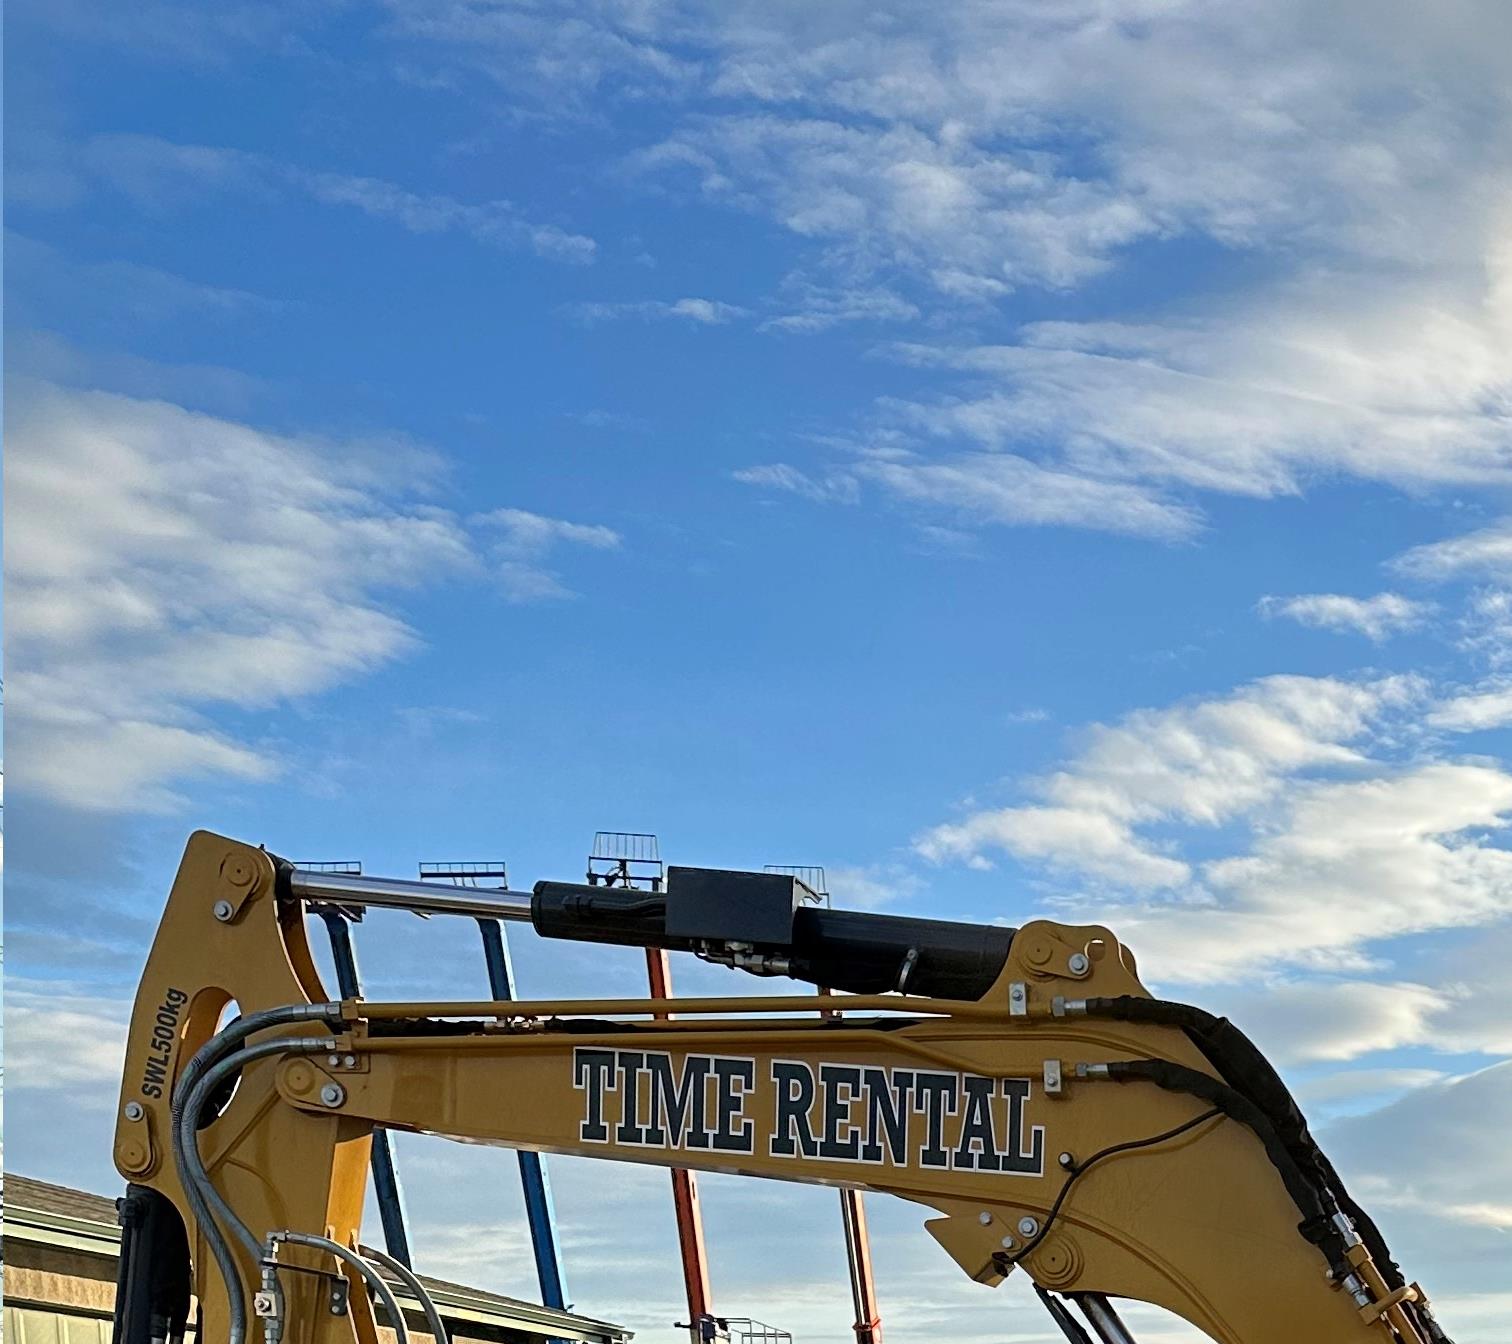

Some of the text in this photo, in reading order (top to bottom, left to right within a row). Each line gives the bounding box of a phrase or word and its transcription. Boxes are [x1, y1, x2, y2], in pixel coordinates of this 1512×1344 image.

[141, 988, 188, 1099] SWL500kg
[573, 1046, 1045, 1177] TIME RENTAL
